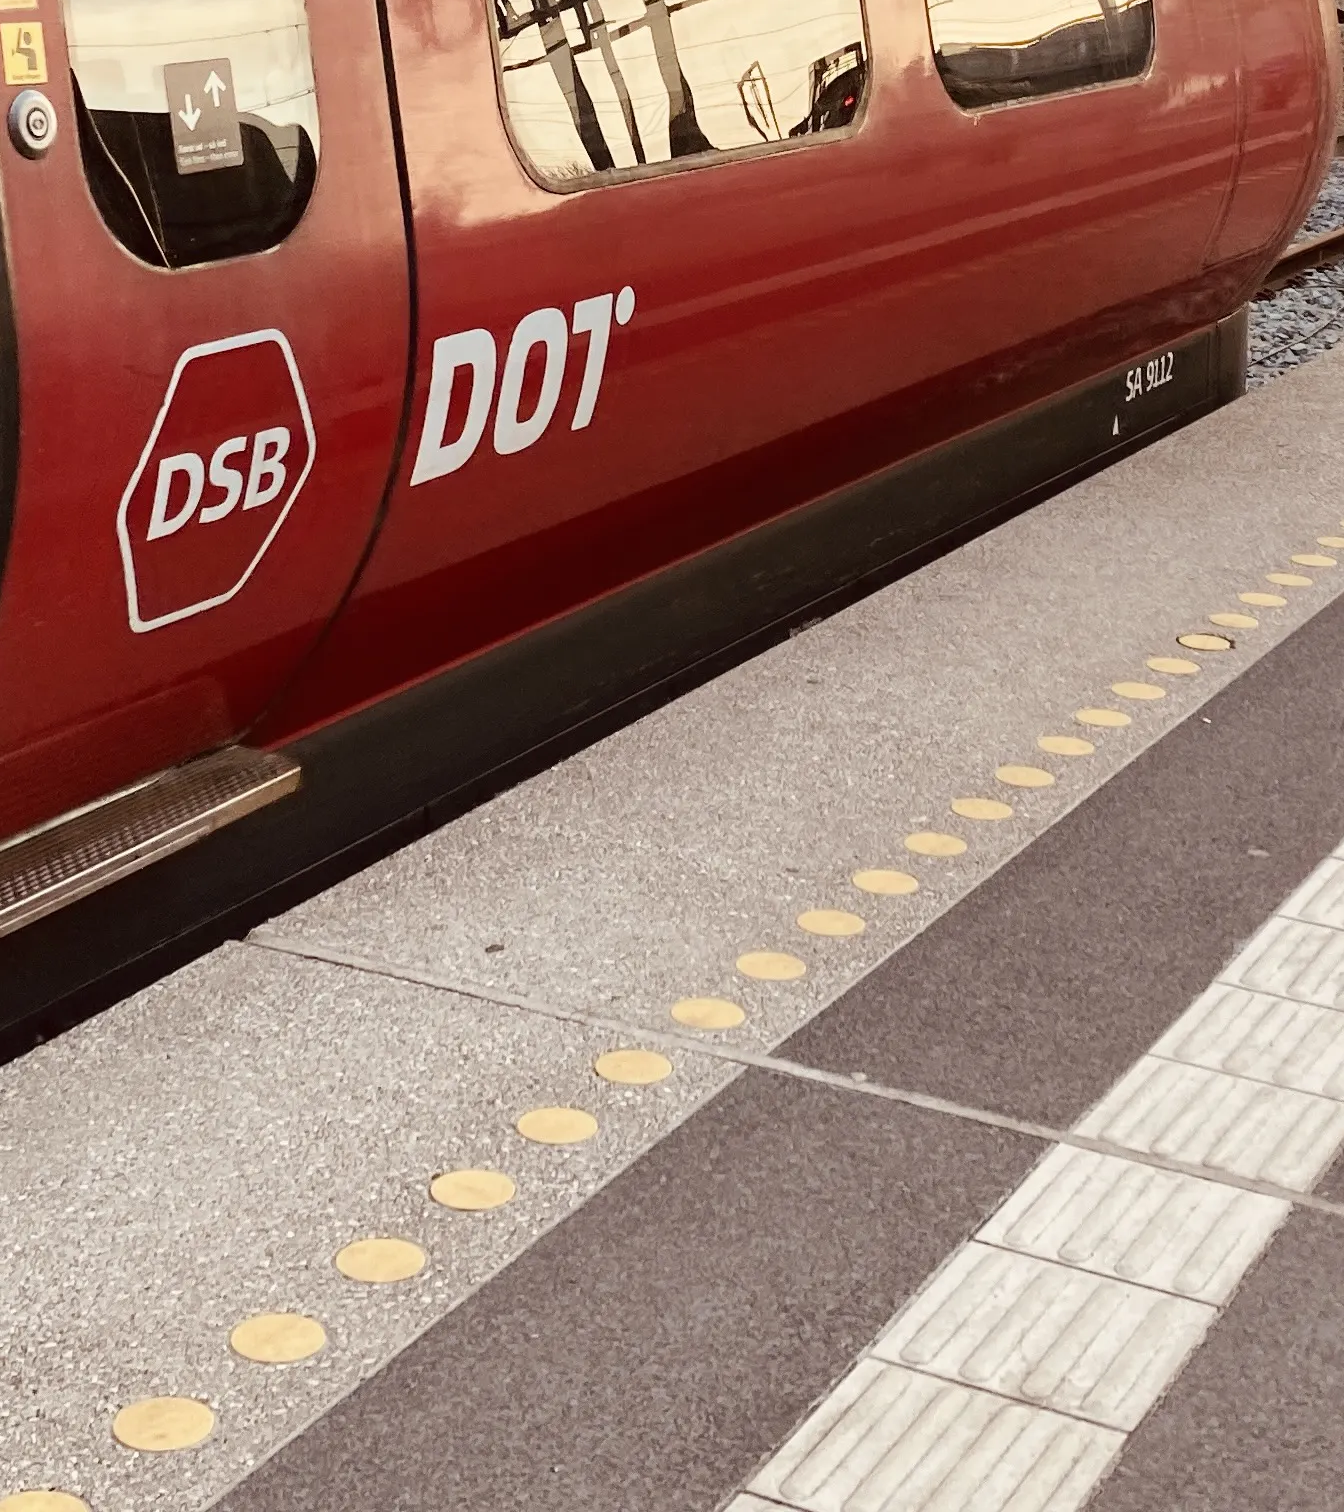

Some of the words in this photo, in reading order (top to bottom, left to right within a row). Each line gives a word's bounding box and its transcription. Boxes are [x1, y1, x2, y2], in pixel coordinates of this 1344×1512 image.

[410, 286, 636, 487] DOT
[1126, 367, 1142, 402] SA
[1146, 351, 1174, 392] 9112
[146, 425, 292, 541] DSB
